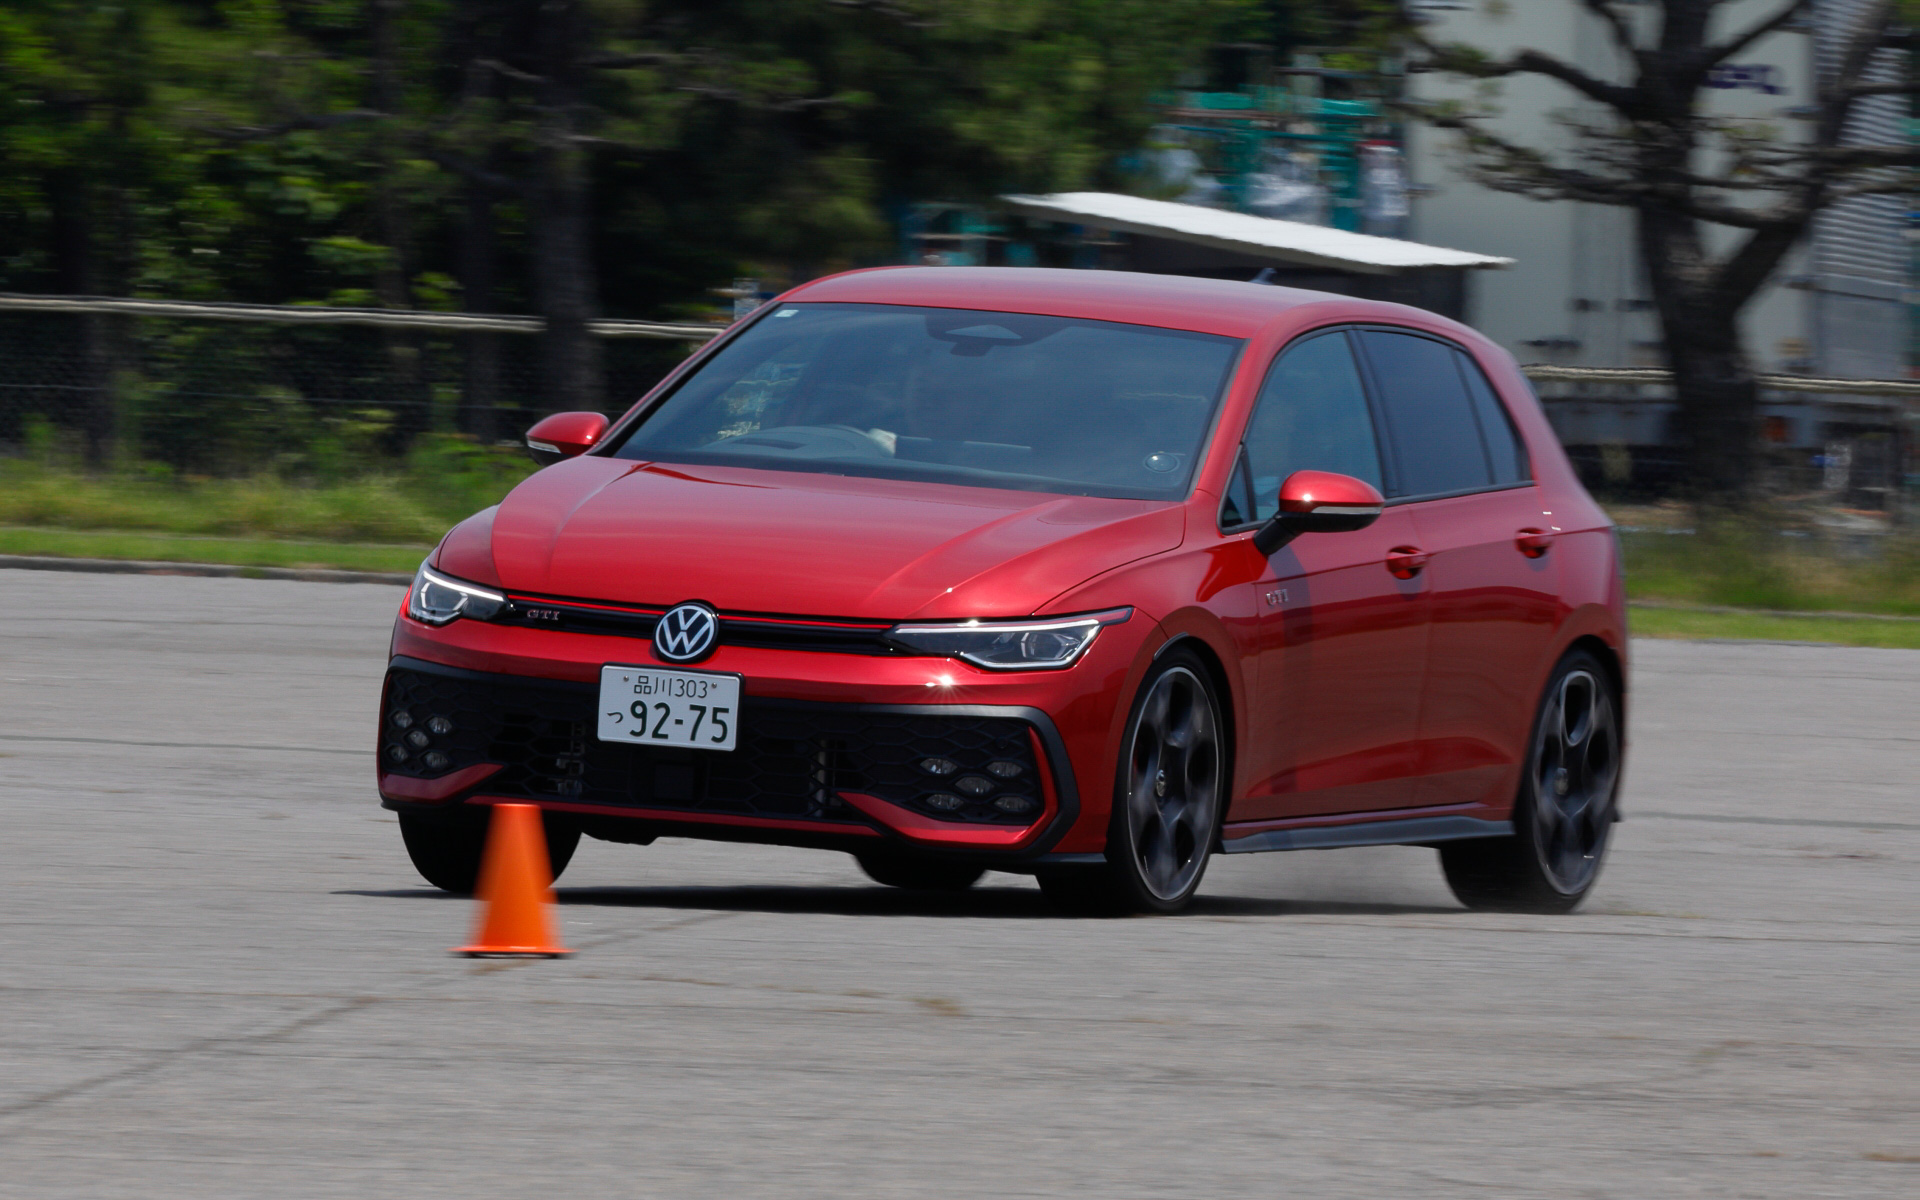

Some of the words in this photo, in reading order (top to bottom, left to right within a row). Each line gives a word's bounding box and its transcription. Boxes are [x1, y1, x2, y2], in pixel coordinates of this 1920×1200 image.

[527, 609, 560, 620] GTI
[659, 606, 713, 656] VW
[607, 711, 624, 724] つ
[629, 700, 730, 743] 92-75
